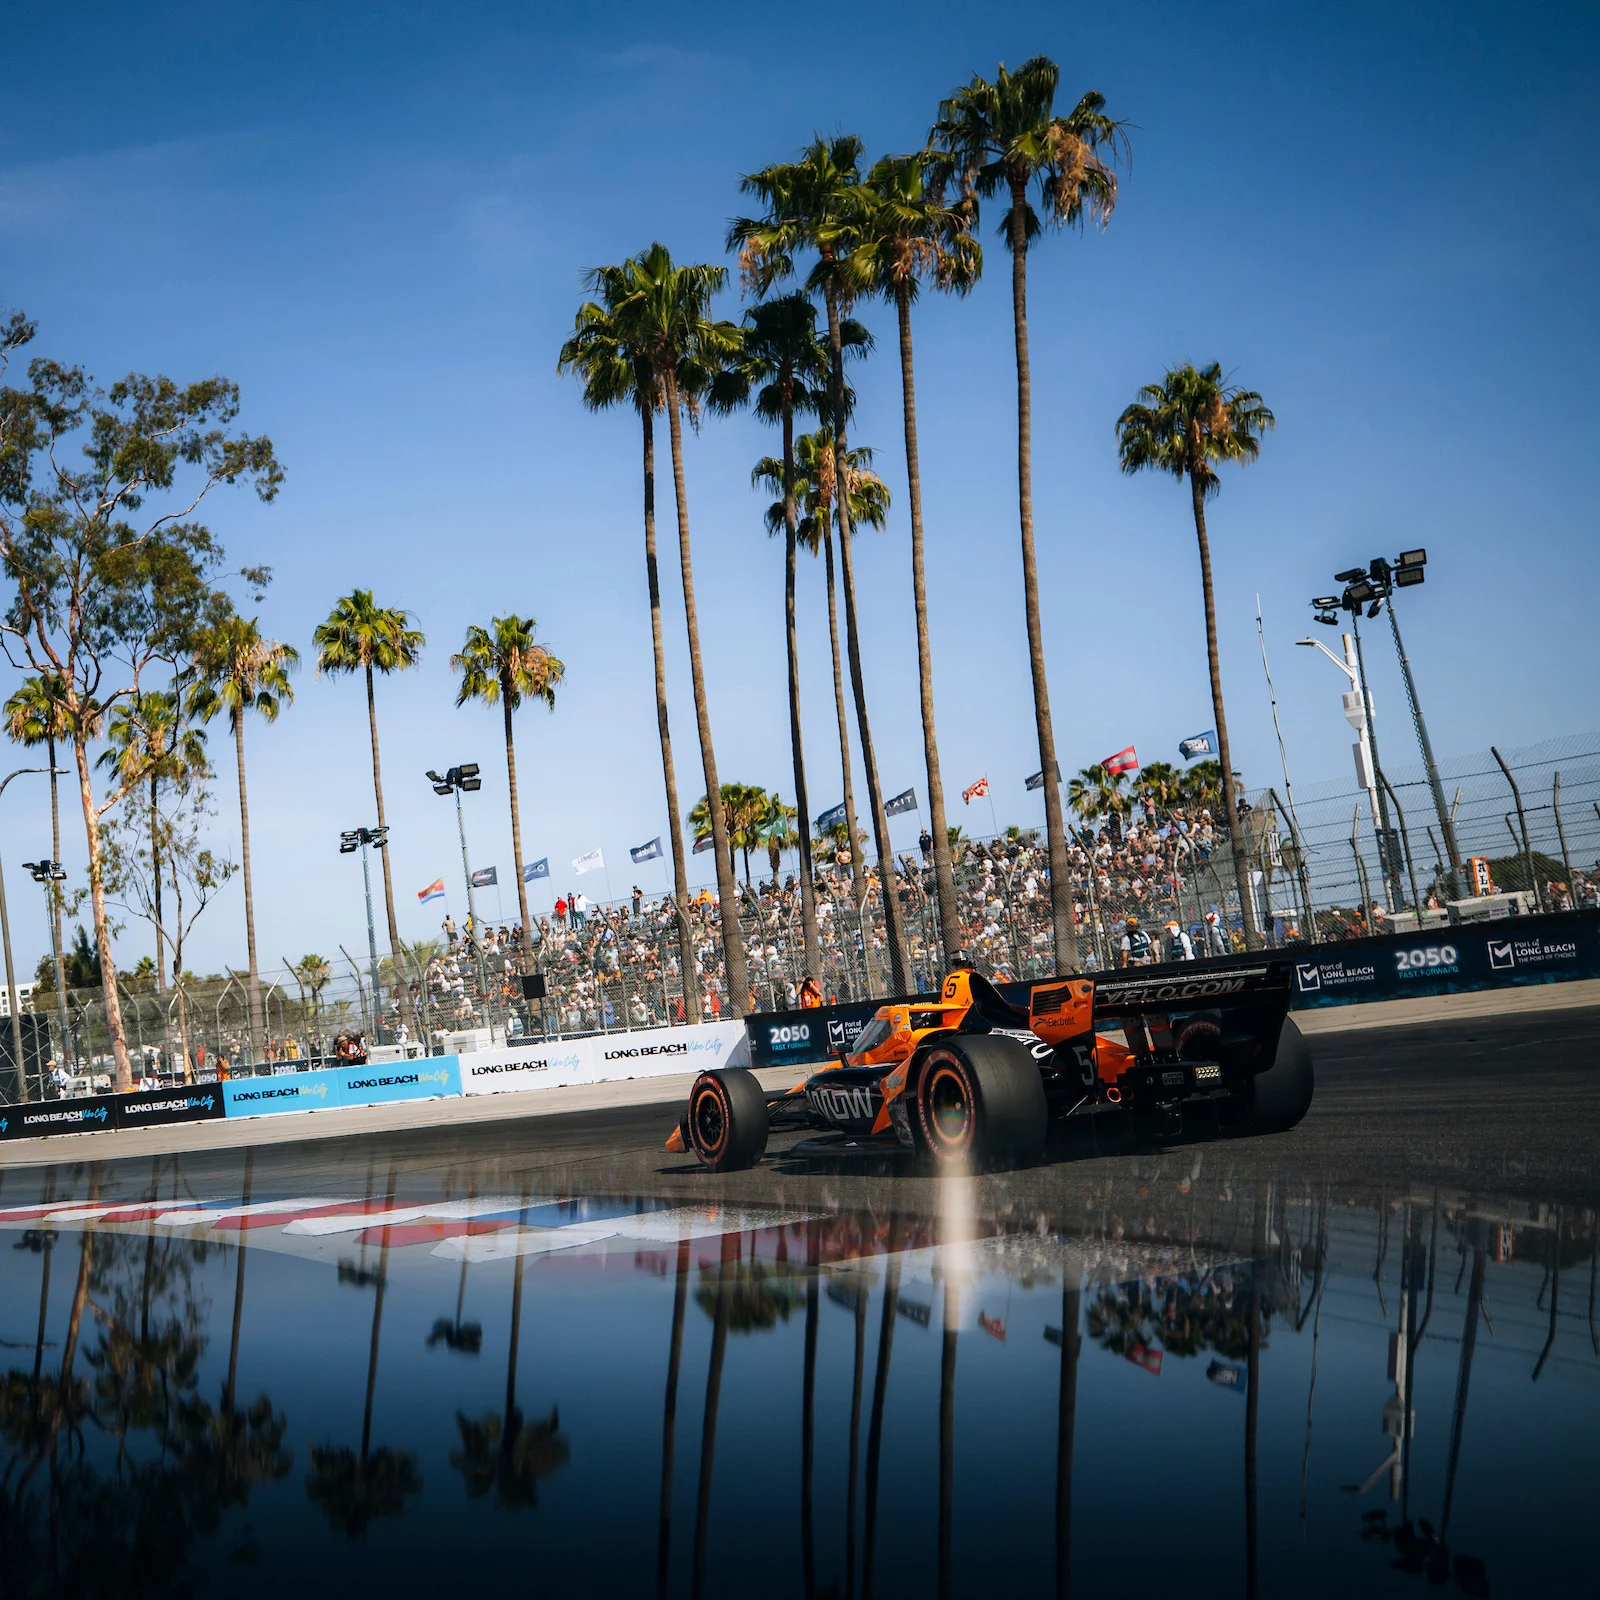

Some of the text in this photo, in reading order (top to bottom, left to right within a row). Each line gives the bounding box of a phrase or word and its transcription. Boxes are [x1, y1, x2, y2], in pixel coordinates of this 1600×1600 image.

[1514, 938, 1540, 949] Port of
[1516, 942, 1576, 957] LONG BEACH
[1395, 945, 1457, 970] 2050
[1320, 962, 1343, 972] Port of
[1322, 966, 1375, 979] LONG BEACH
[1399, 969, 1420, 979] FAST.
[944, 975, 961, 998] 5
[846, 1026, 862, 1035] LONG
[855, 1019, 862, 1027] of
[770, 1024, 810, 1044] 2050
[605, 1037, 724, 1060] LONG BEACH Vibe City
[471, 1064, 504, 1076] LONG
[504, 1059, 548, 1072] BEACH
[547, 1057, 564, 1069] Vibe
[563, 1054, 581, 1072] City
[1072, 1045, 1095, 1086] 5
[347, 1079, 378, 1090] LONG
[378, 1074, 419, 1086] BEACH
[233, 1092, 261, 1102] LONG
[261, 1087, 299, 1098] BEACH
[125, 1103, 152, 1114] LONG
[152, 1099, 187, 1110] BEACH
[24, 1112, 49, 1124] LONG
[49, 1110, 82, 1121] BEACH
